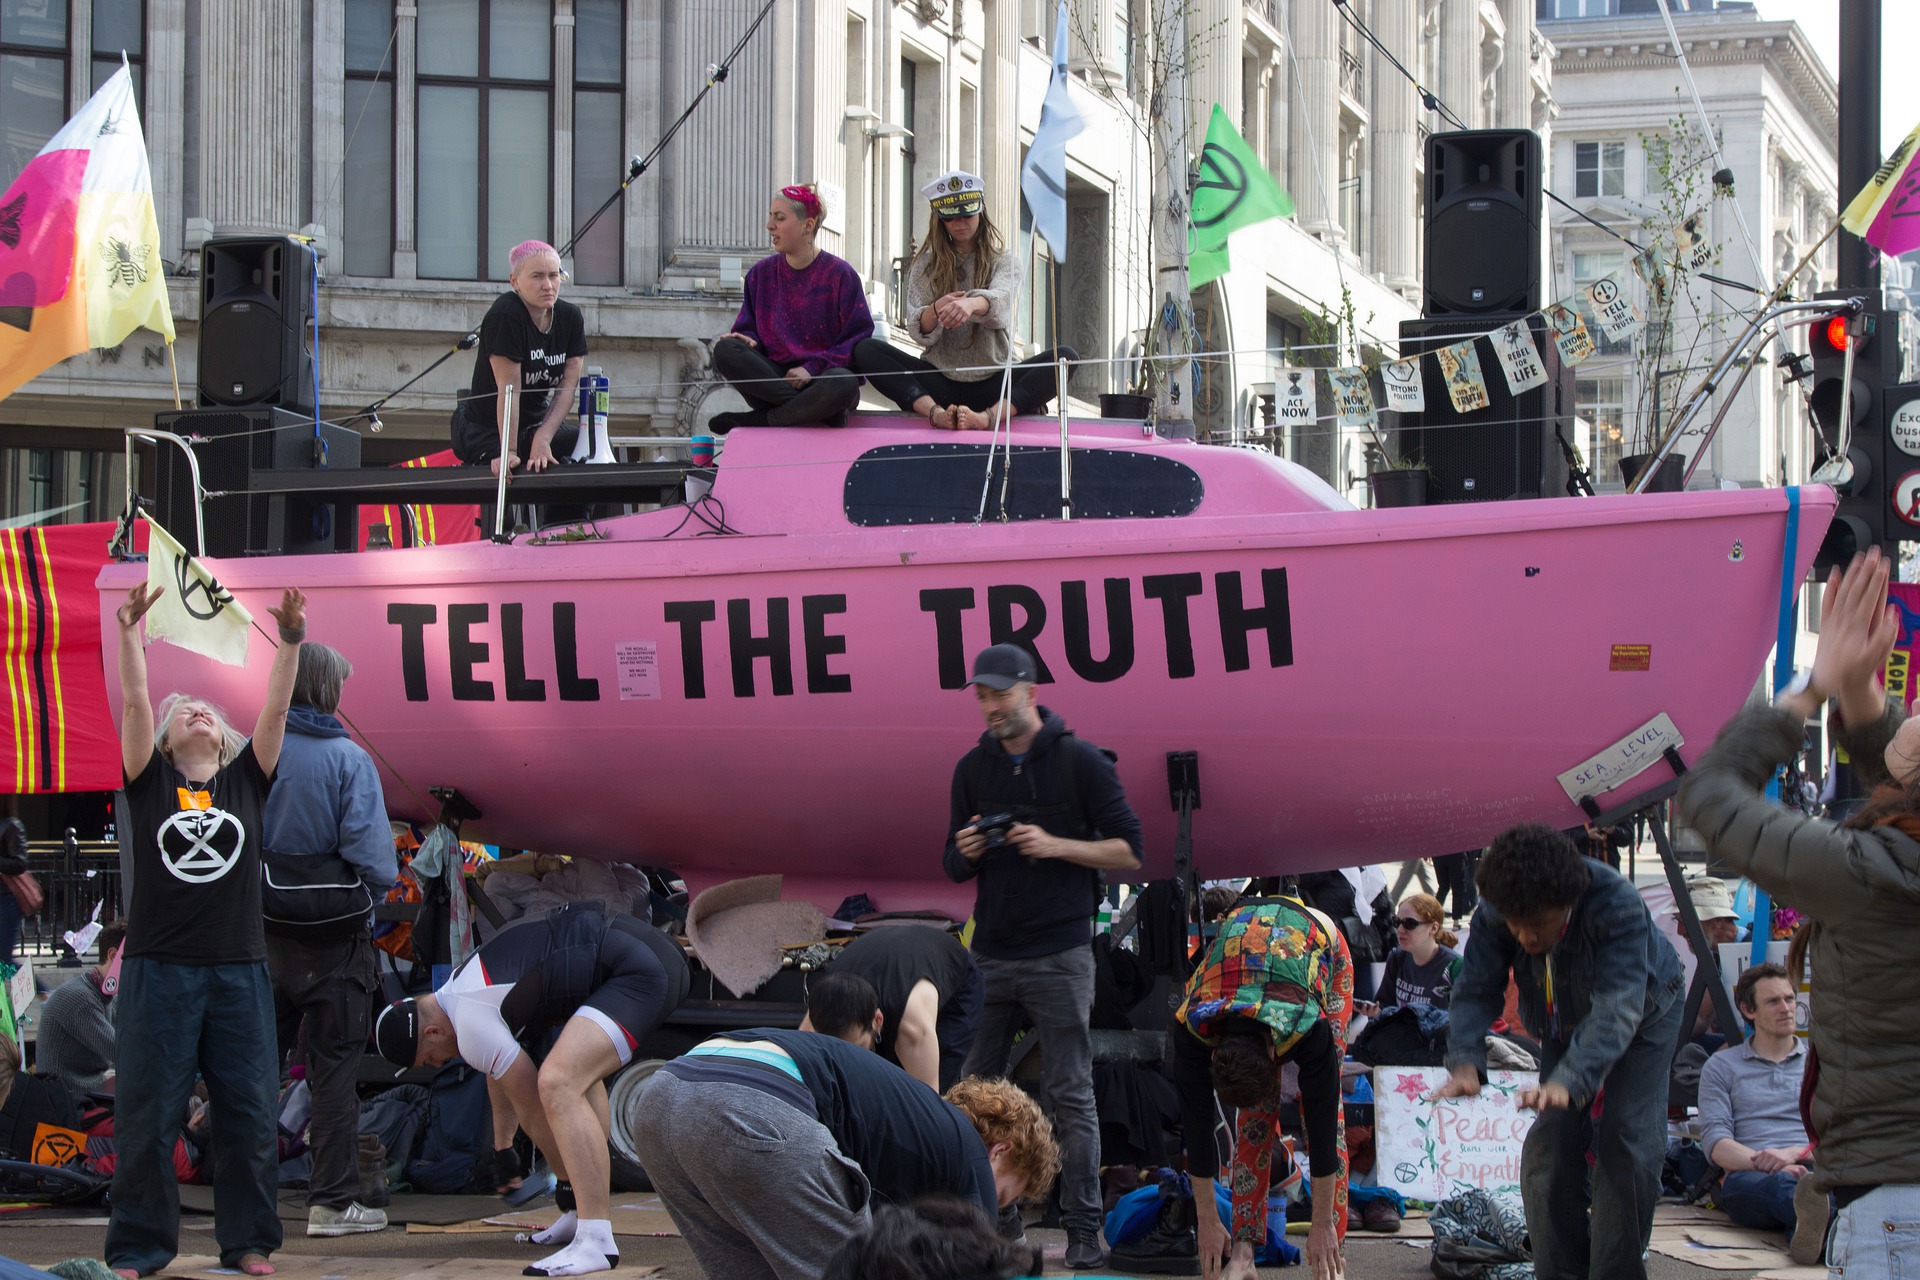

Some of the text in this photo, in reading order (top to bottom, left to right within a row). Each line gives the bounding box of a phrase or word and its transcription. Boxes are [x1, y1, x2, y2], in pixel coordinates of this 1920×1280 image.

[943, 197, 954, 206] FOR
[1693, 242, 1707, 257] ACT
[1690, 248, 1713, 270] NOW
[1602, 299, 1628, 318] TELL
[1611, 315, 1636, 332] TRUTH
[1613, 311, 1627, 322] THE
[1560, 331, 1587, 350] BEYOND
[1507, 346, 1531, 362] REBEL
[1564, 340, 1590, 357] POLITICS
[1515, 358, 1528, 368] FOR
[1513, 364, 1539, 383] LIFE
[1390, 385, 1418, 394] BEYOND
[1393, 392, 1418, 400] POLITICS
[1287, 398, 1304, 407] ACT
[1342, 394, 1365, 406] NON
[1456, 391, 1484, 406] TRUTH
[1281, 407, 1310, 418] NOW
[387, 567, 1294, 702] TELL THE TRUTH
[1575, 726, 1664, 785] SEA LEVEL
[1430, 1106, 1526, 1145] Peace
[1487, 1143, 1508, 1153] with
